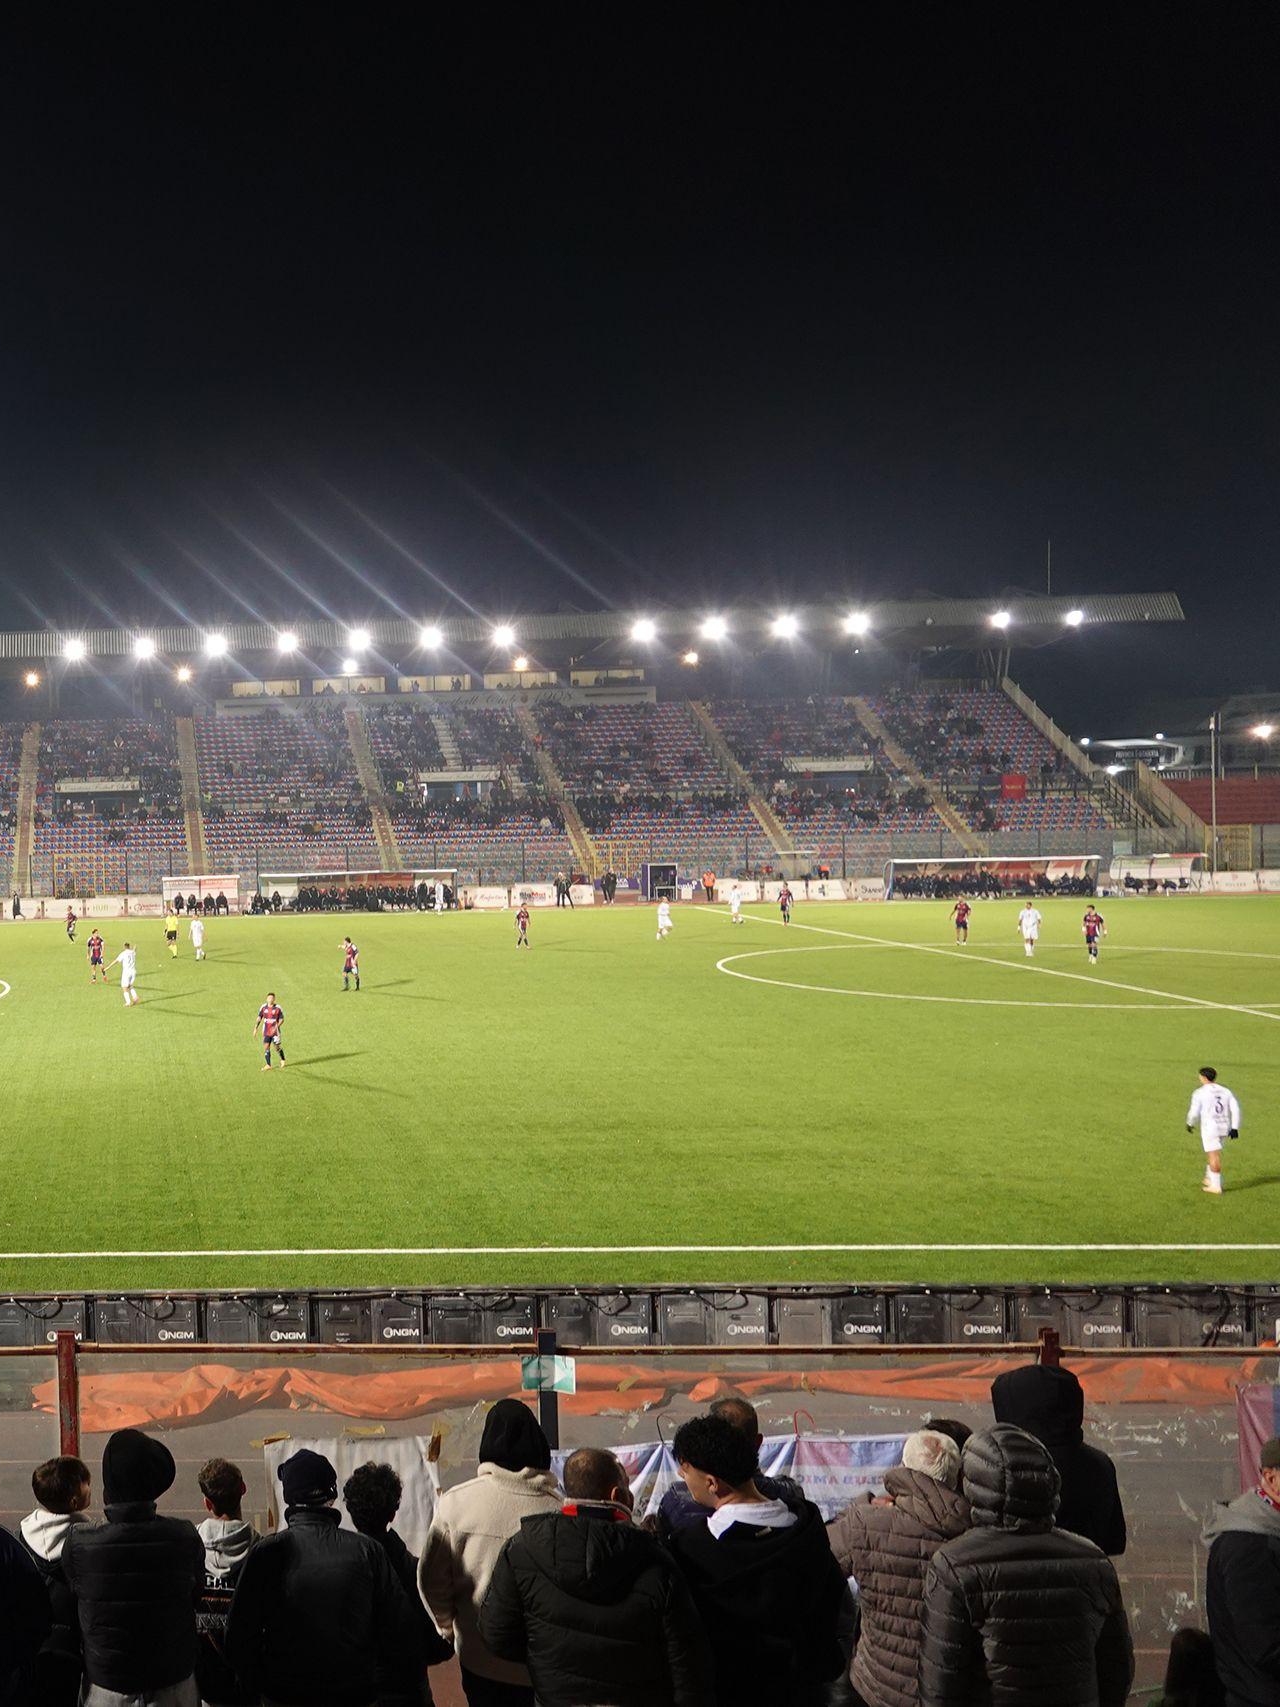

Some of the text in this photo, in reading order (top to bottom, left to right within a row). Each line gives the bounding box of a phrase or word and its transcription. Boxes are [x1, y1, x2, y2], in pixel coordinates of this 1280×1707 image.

[393, 1328, 419, 1336] NGM
[507, 1327, 534, 1335] NGM
[620, 1325, 648, 1334] NGM
[736, 1325, 764, 1334] NGM
[854, 1325, 882, 1334] NGM
[974, 1325, 1002, 1334] NGM
[1094, 1325, 1122, 1334] NGM
[169, 1331, 194, 1340] NGM
[280, 1332, 306, 1340] NGM
